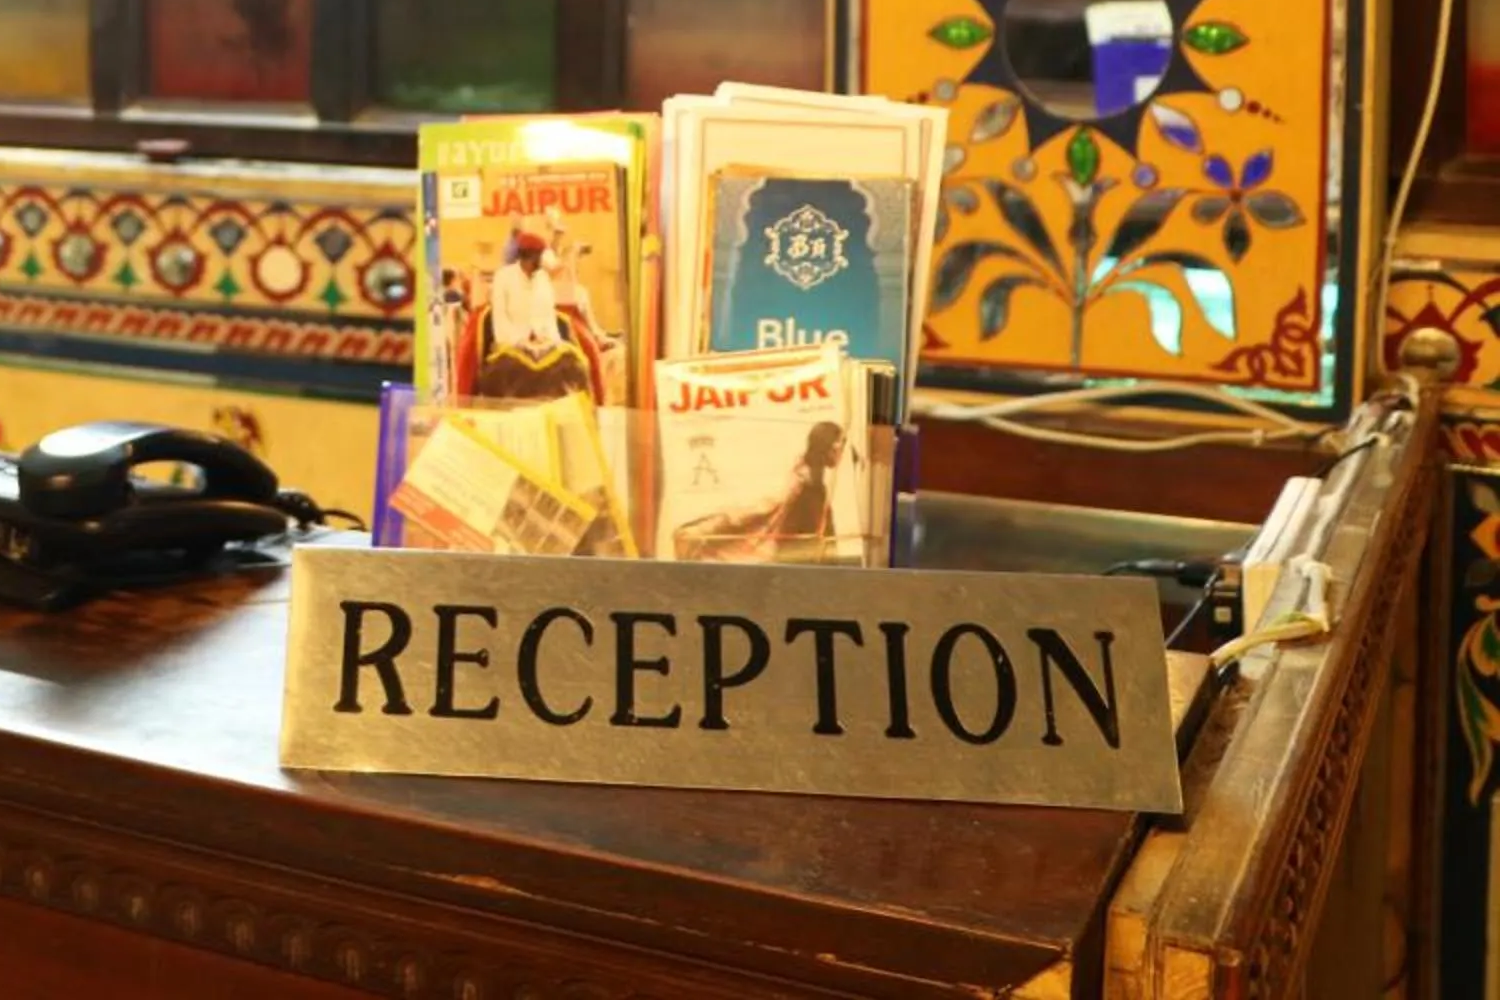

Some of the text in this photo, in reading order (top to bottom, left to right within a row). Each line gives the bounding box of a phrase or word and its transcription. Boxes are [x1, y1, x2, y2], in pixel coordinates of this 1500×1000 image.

[481, 184, 614, 217] JAIPUR
[756, 316, 849, 356] Blue
[333, 600, 1122, 749] RECEPTION
